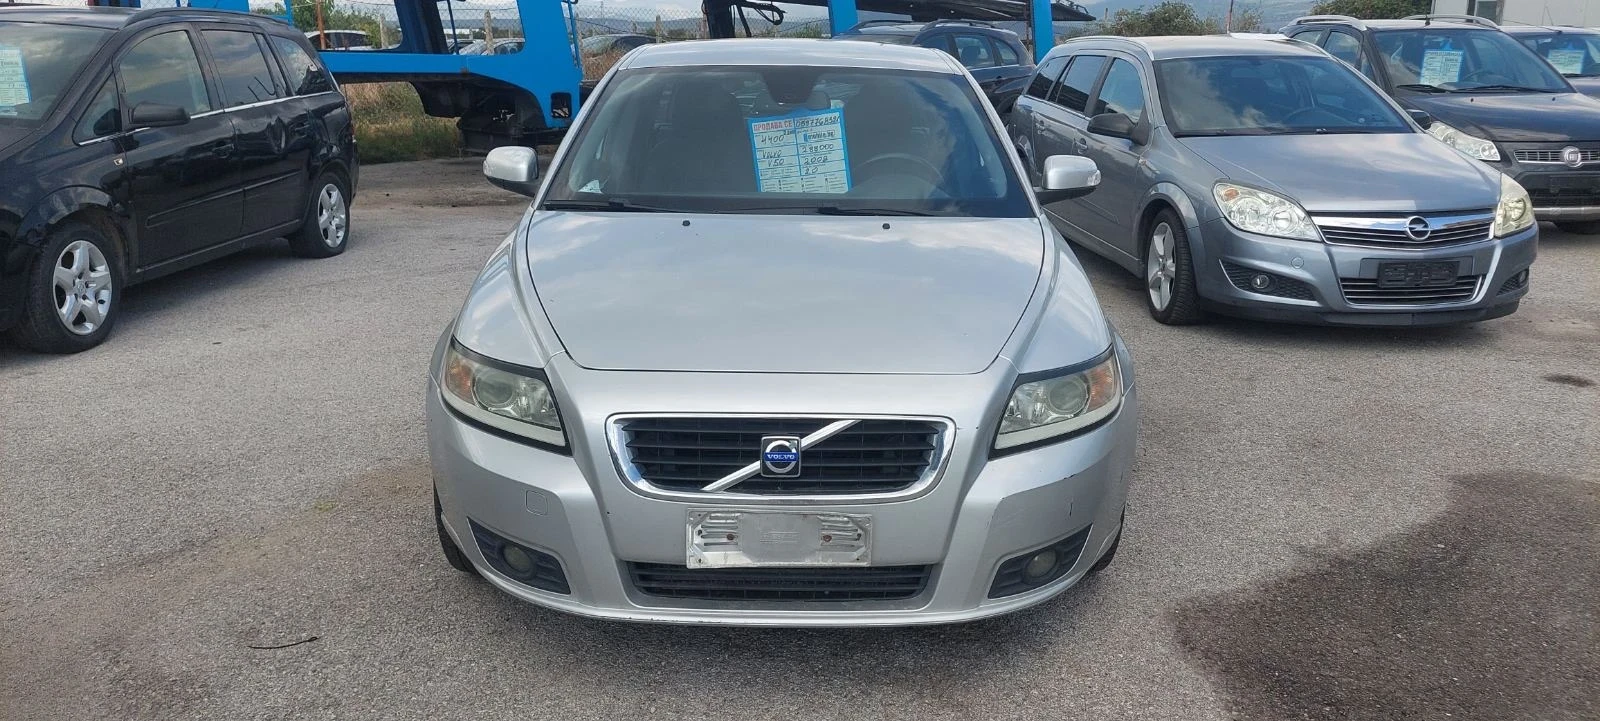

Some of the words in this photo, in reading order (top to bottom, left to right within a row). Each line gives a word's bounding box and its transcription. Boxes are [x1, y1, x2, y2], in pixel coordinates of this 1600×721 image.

[753, 121, 783, 131] ПРОДАВА
[784, 120, 792, 128] СЕ
[761, 135, 784, 144] 4400
[762, 150, 782, 159] VOLVO
[768, 159, 785, 167] V50
